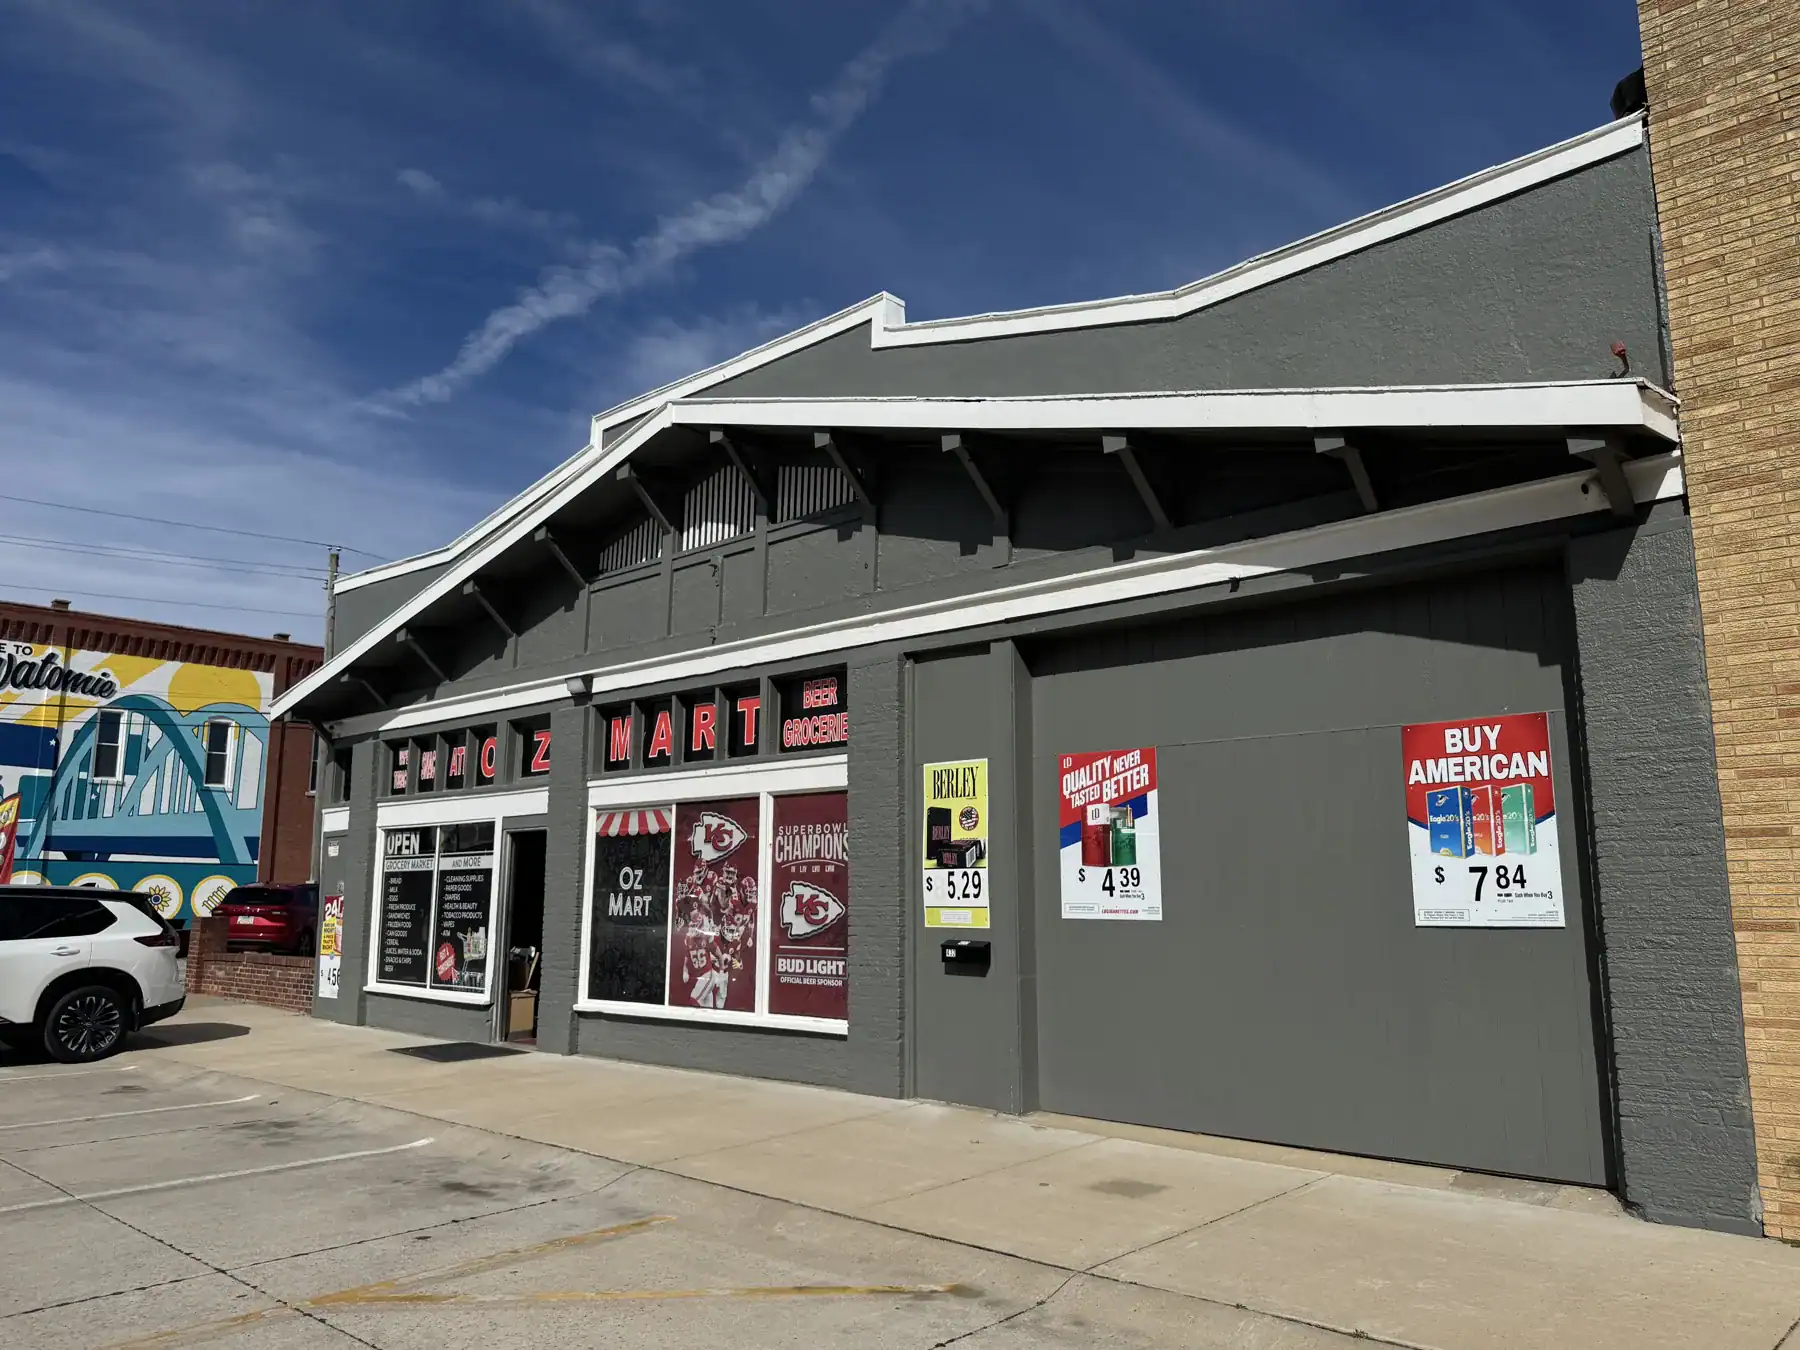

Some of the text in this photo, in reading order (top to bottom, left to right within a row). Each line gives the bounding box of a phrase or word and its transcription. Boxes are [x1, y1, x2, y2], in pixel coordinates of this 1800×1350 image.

[13, 644, 33, 656] TO
[803, 677, 838, 708] BEER
[1444, 724, 1502, 754] BUY
[1062, 749, 1140, 799] QUALITY NEVER
[1408, 750, 1549, 785] AMERICAN
[932, 766, 979, 799] BERLEY
[1070, 763, 1149, 809] TASTED BETTER
[387, 831, 420, 855] OPEN
[386, 859, 433, 870] GROCERY MARKET
[452, 856, 481, 868] AND MORE
[926, 870, 982, 900] $ 5.29
[1078, 867, 1141, 898] $ 4 39
[1140, 892, 1145, 900] 3
[1434, 864, 1527, 902] $ 7 84
[1547, 890, 1553, 900] 3
[608, 892, 652, 916] MART
[777, 958, 845, 976] BUD LIGHT
[780, 976, 843, 987] OFFICIAL BEER SPONSOR
